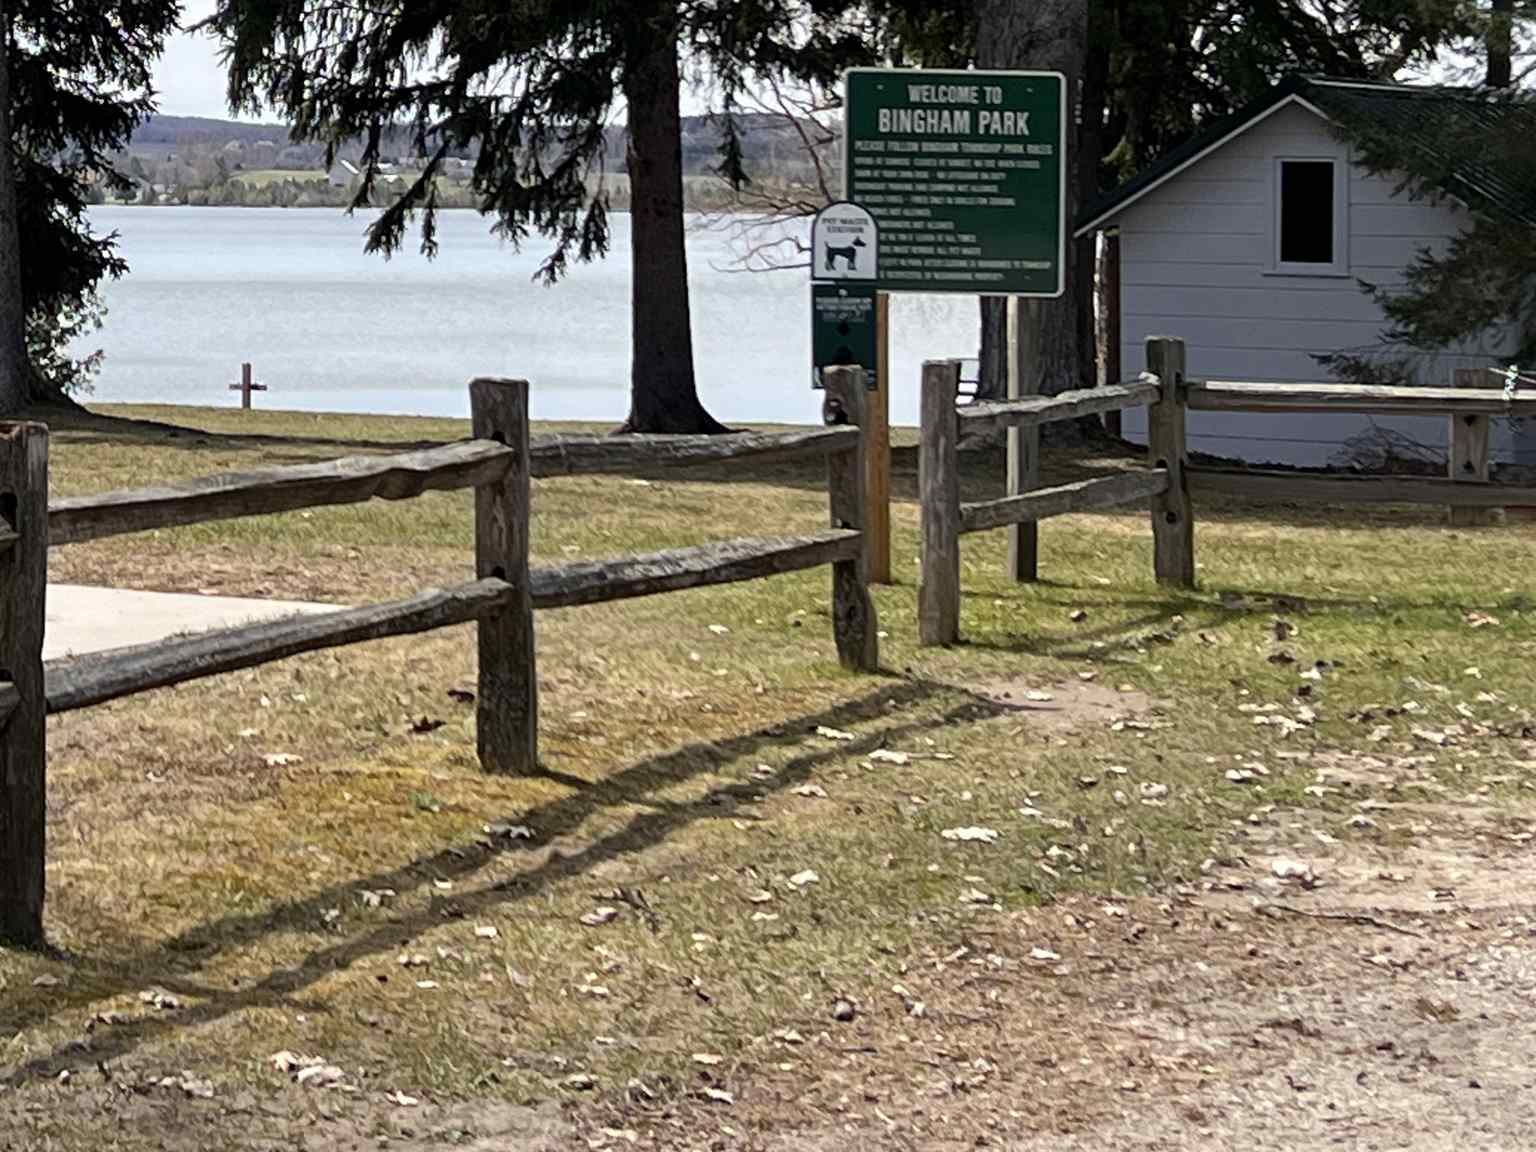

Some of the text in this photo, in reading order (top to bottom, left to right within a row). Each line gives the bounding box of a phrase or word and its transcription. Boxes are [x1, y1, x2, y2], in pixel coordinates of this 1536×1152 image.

[907, 84, 1003, 104] WELCOME TO
[878, 108, 1030, 136] BINGHAM PARK
